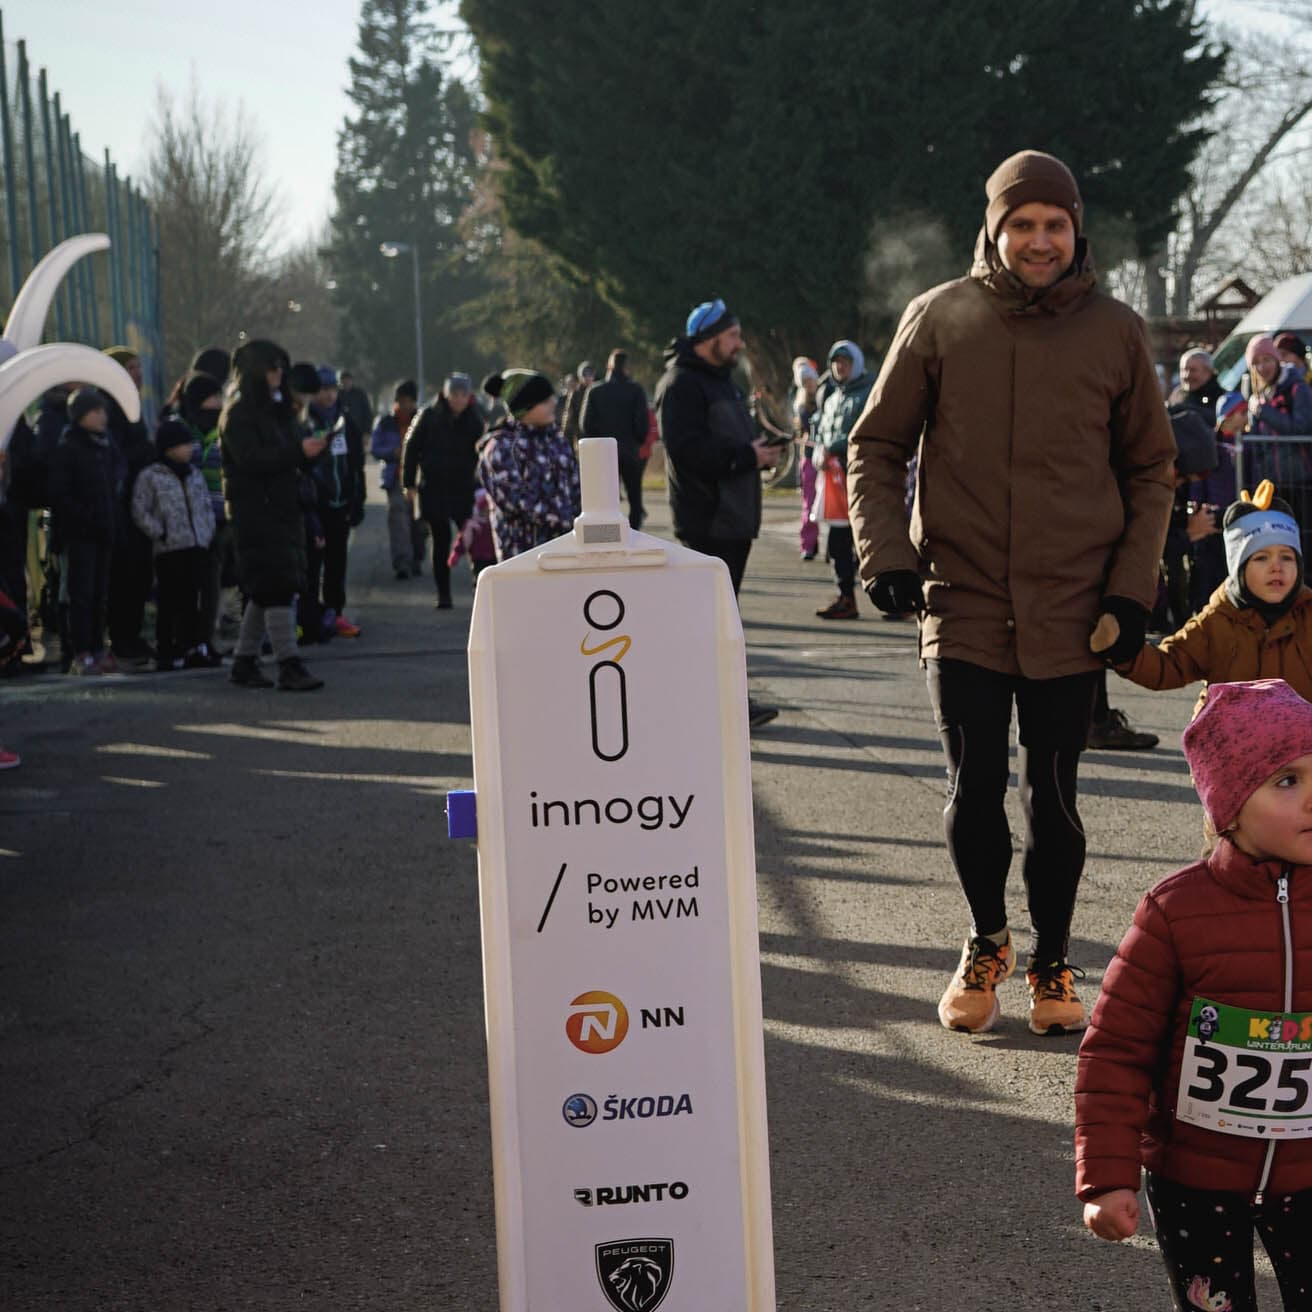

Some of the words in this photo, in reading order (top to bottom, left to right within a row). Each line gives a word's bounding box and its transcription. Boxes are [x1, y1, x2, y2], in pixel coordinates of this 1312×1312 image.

[530, 791, 694, 831] innogy
[587, 866, 699, 894] Powered
[588, 902, 619, 929] by
[631, 896, 699, 921] MVM
[640, 1006, 685, 1029] NN
[602, 1093, 693, 1121] ŠKODA
[596, 1181, 689, 1206] RUNTO
[602, 1244, 666, 1257] PEUGEOT
